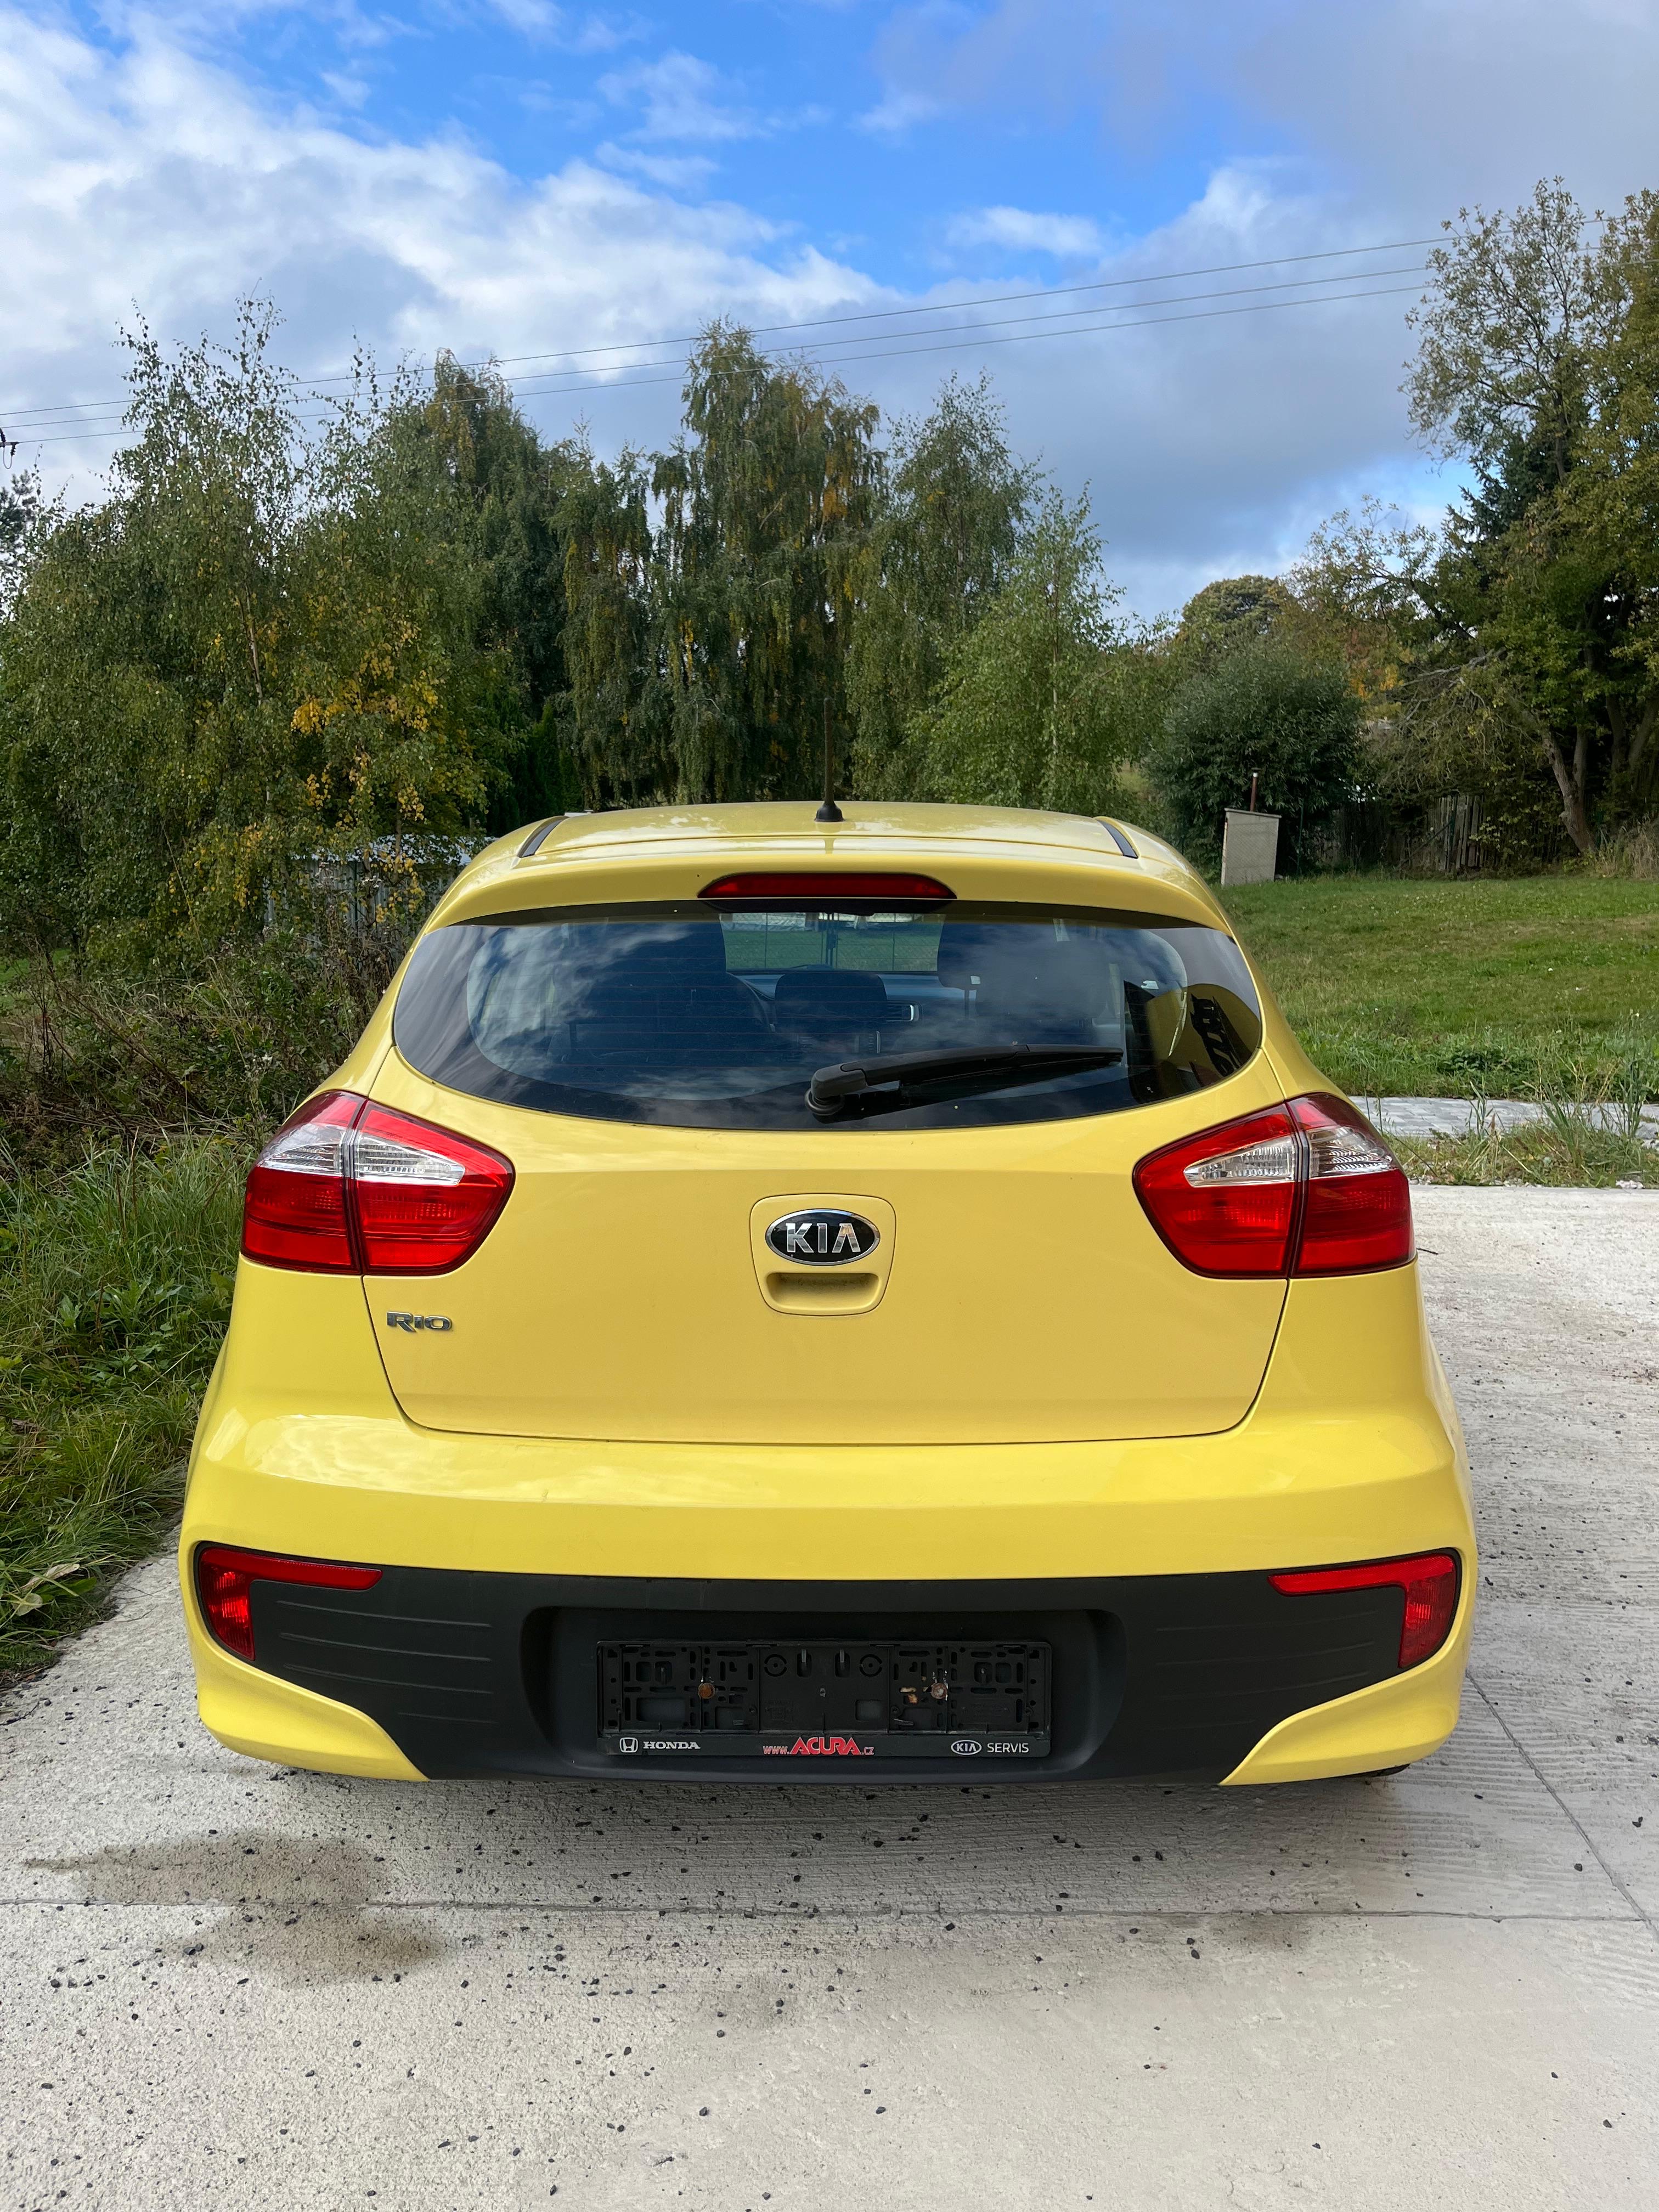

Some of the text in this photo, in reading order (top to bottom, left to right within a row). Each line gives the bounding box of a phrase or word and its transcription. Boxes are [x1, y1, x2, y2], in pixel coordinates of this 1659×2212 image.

[785, 1223, 861, 1253] KIA
[643, 1741, 701, 1750] HONDA
[956, 1742, 1029, 1753] KIA SERVIS
